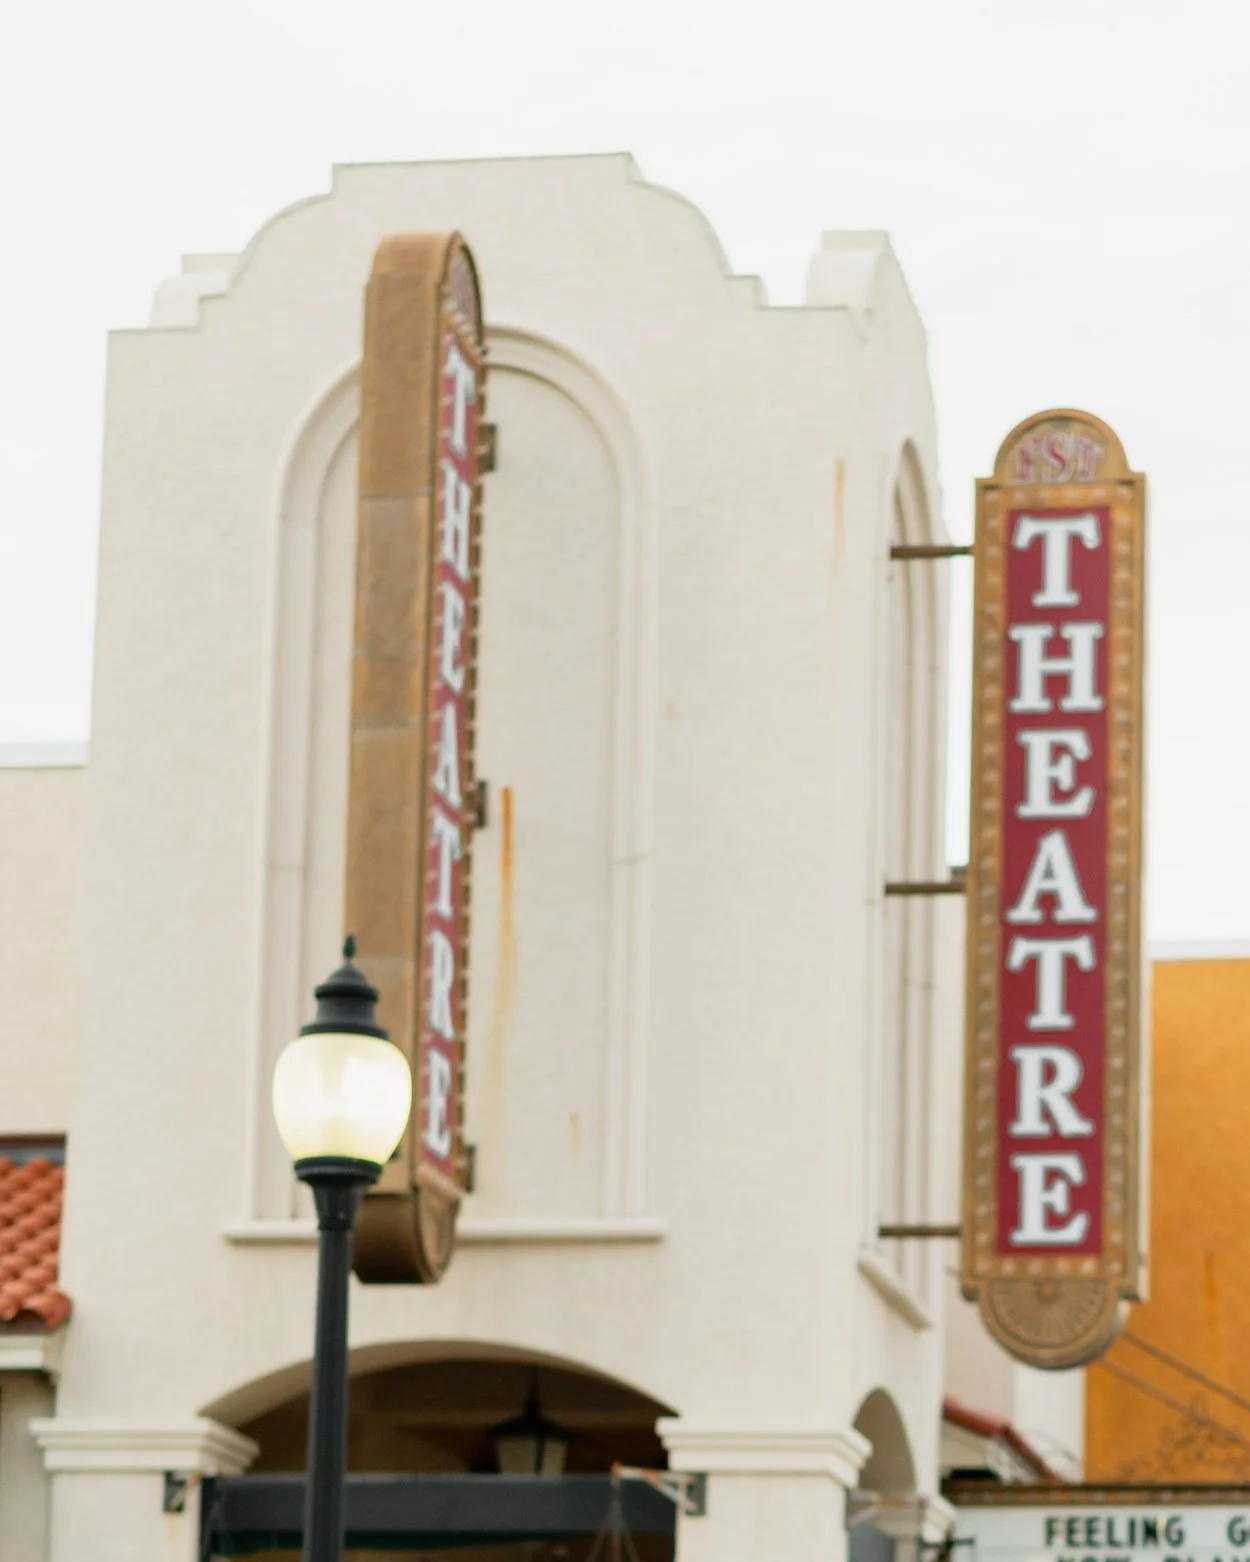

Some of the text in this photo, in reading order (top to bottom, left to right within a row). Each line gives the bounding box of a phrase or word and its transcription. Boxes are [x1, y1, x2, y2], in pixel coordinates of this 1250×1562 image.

[425, 343, 475, 1158] THEATRE
[1006, 513, 1104, 1245] THEATRE
[1045, 1516, 1185, 1548] FEELING
